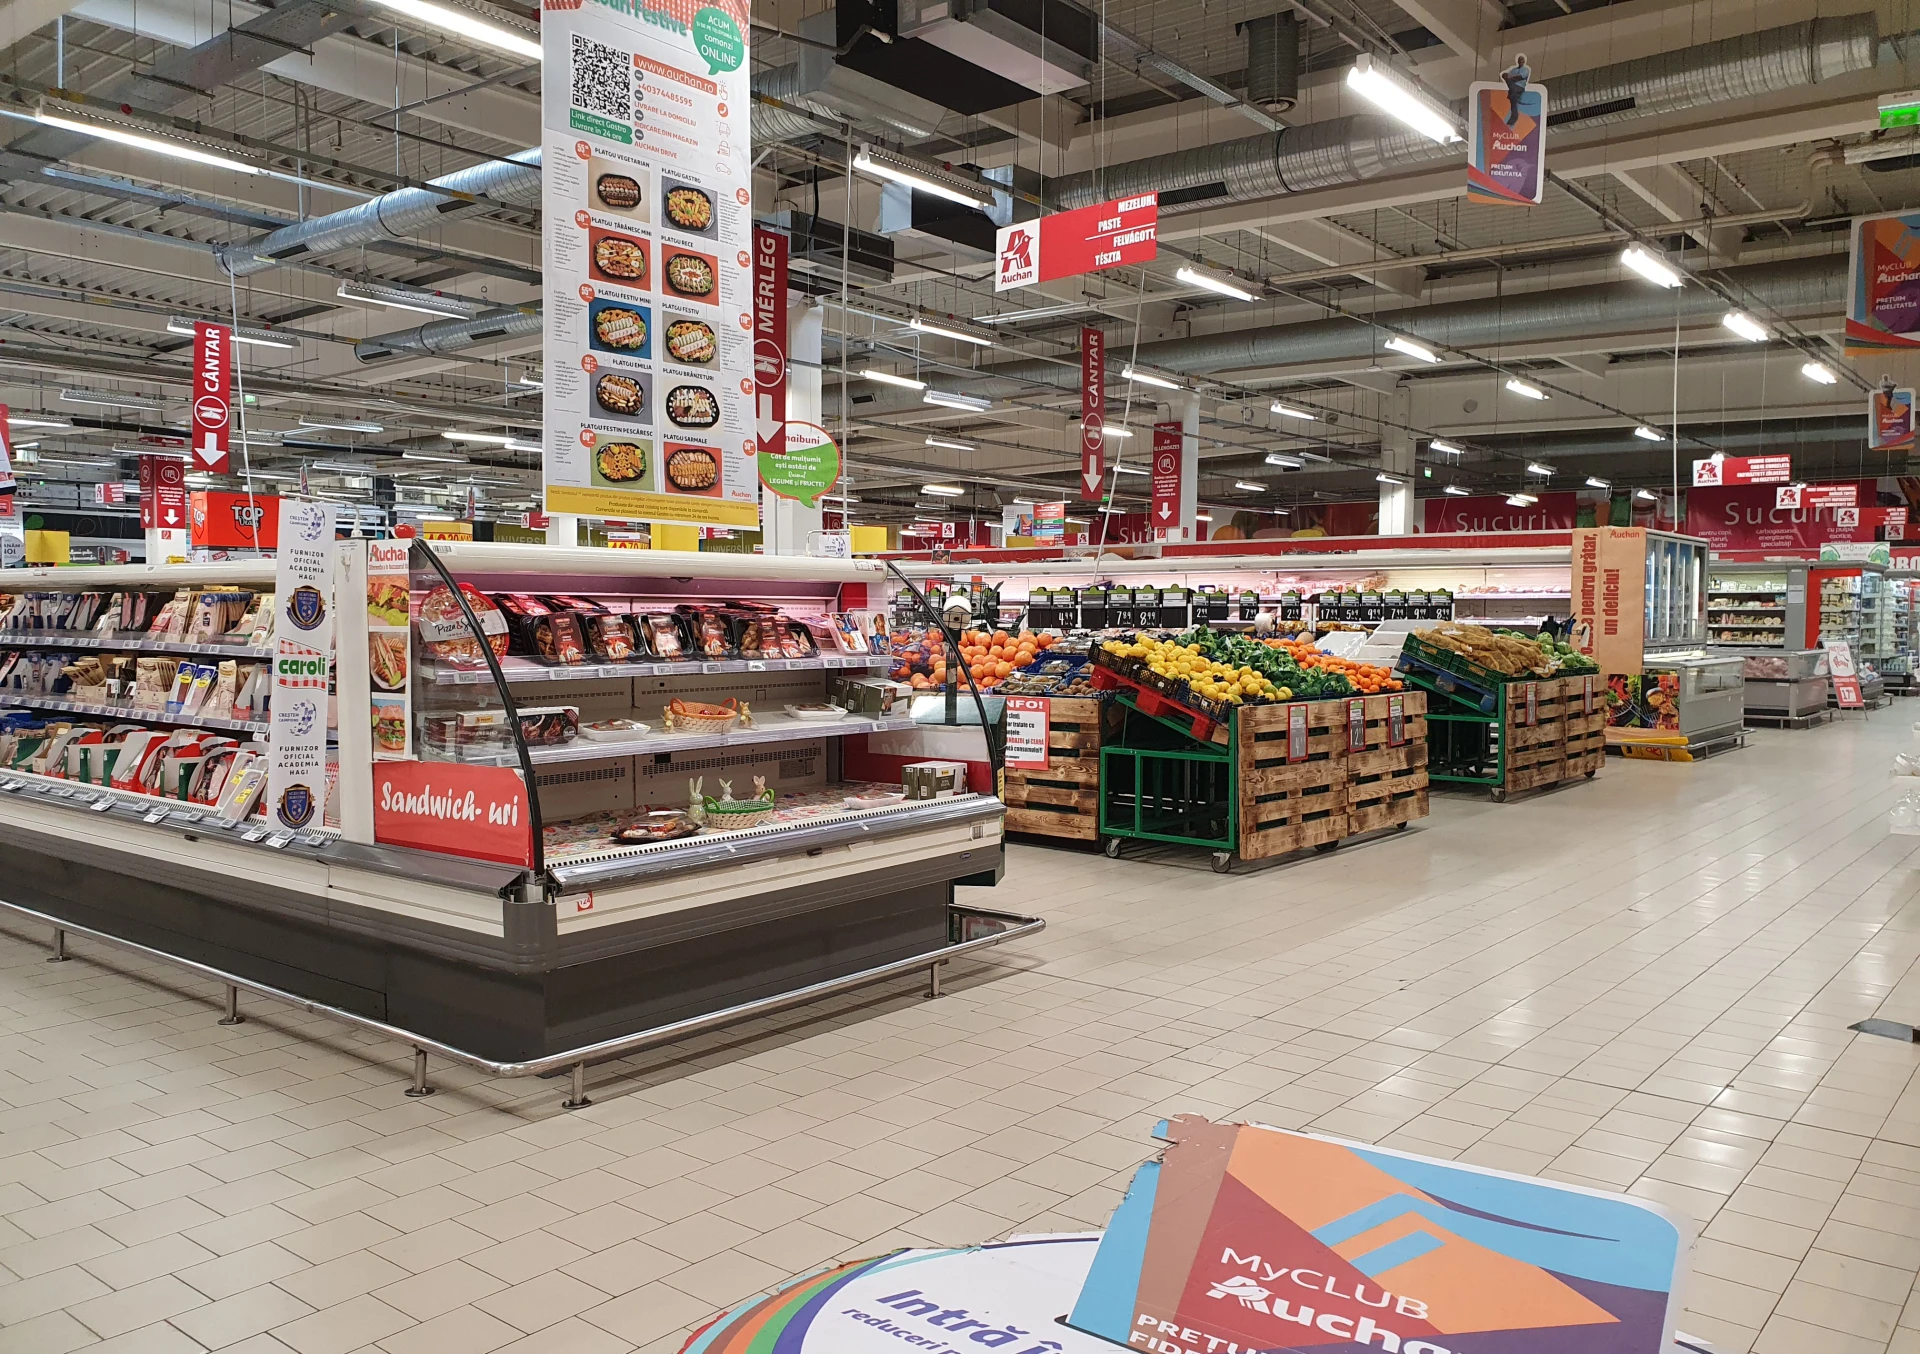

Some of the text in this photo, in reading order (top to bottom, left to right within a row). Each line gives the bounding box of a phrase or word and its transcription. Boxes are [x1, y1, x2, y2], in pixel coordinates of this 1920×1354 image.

[634, 0, 686, 37] Festive
[708, 15, 730, 30] ACUM
[705, 34, 733, 50] comanzi
[701, 45, 736, 67] ONLINE
[638, 59, 714, 93] www.auchan.ro
[572, 110, 627, 133] Link direct Gastro
[634, 102, 696, 126] LIVRARE LA DOMICILIU
[572, 120, 592, 132] Livrare
[603, 129, 611, 138] 24
[612, 133, 622, 141] ore
[634, 121, 698, 146] RIDICARE DIN MAGAZIN
[1492, 132, 1519, 140] MyCLUB
[634, 141, 677, 158] AUCHAN DRIVE
[1492, 140, 1527, 152] Auchan
[618, 154, 650, 167] VEGETARIAN
[682, 174, 701, 183] GASTRO
[1491, 170, 1522, 178] FIDELITATEA
[1118, 194, 1157, 213] MEZELURI,
[1098, 216, 1121, 232] PASTE
[1113, 227, 1156, 248] FELVÁGOTT,
[1095, 250, 1121, 266] TÉSZTA
[1877, 261, 1912, 272] MyCLUB
[755, 236, 776, 334] MÉRLEG
[1001, 270, 1032, 284] Auchan
[682, 307, 699, 315] FESTIV
[1875, 301, 1918, 310] FIDELITATEA
[202, 328, 220, 392] CÂNTAR
[1088, 334, 1098, 408] CÂNTAR
[684, 436, 707, 444] SARMALE
[788, 462, 807, 470] astăzi
[791, 455, 821, 463] mulțumit
[732, 490, 751, 498] Auchan
[194, 507, 205, 521] TOP
[232, 506, 264, 520] TOP
[1456, 509, 1547, 533] Sucuri
[1609, 529, 1640, 539] Auchan
[290, 549, 325, 558] FURNIZOR
[1580, 534, 1598, 573] grătar,
[289, 564, 325, 574] ACADEMIA
[293, 558, 321, 566] OFICIAL
[298, 573, 316, 581] HAGI
[1581, 575, 1596, 616] pentru
[1602, 568, 1620, 635] un deliciu!
[435, 624, 456, 635] Pizza
[279, 657, 326, 676] caroli
[278, 760, 319, 768] ACADEMIA
[381, 781, 518, 826] Sandwich- uri
[1220, 1247, 1429, 1319] MyCLUB
[875, 1290, 1030, 1348] Intră
[1205, 1275, 1453, 1354] Aucha
[841, 1309, 949, 1350] reduceri
